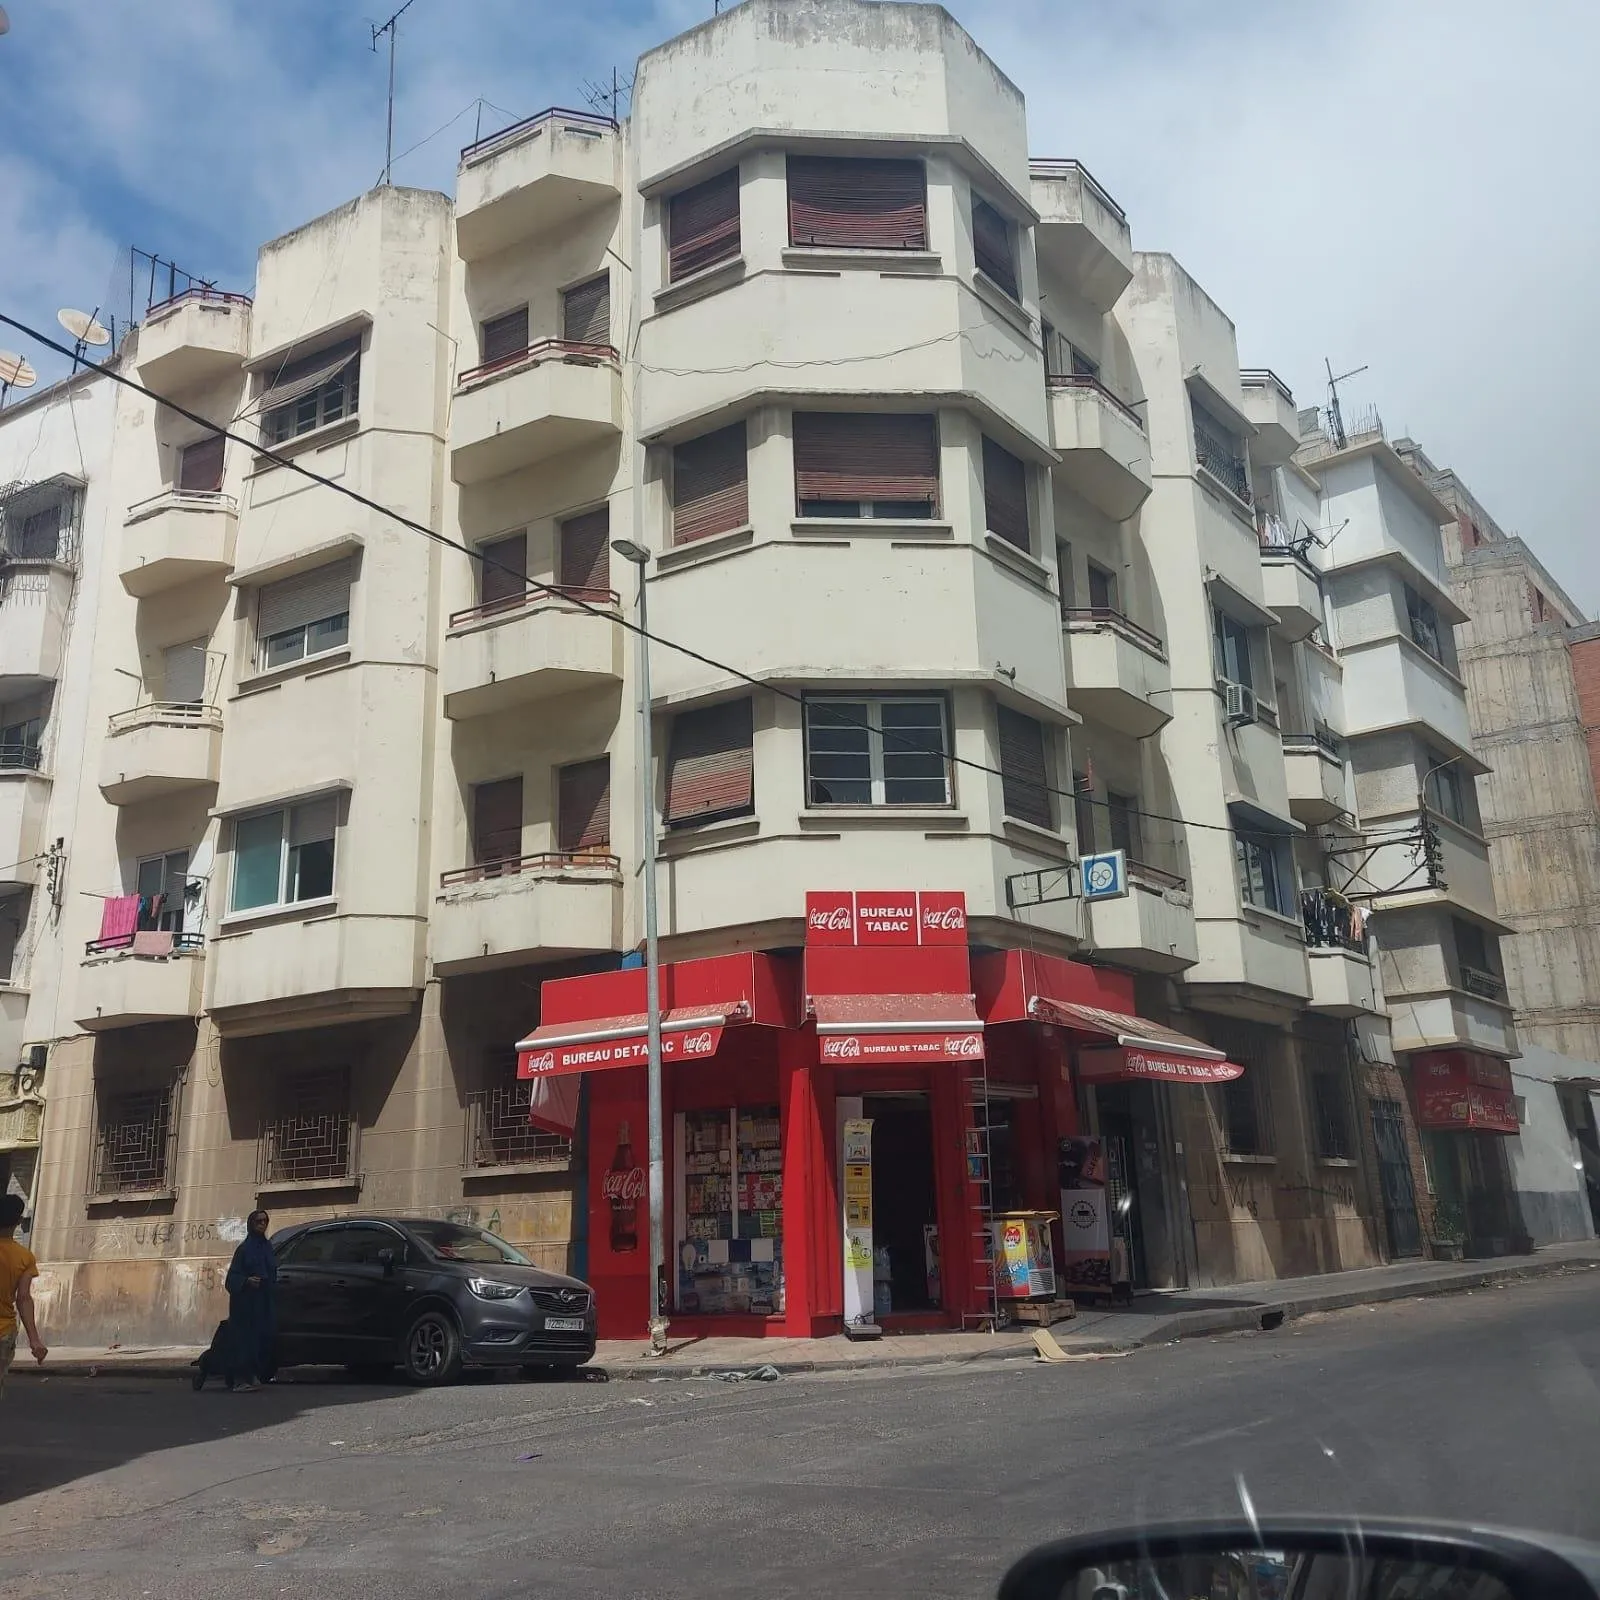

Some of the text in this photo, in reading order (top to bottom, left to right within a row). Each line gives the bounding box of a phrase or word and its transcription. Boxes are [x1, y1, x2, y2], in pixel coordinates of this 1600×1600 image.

[808, 907, 852, 931] Coca-Cola
[860, 907, 913, 918] BUREAU
[922, 906, 965, 930] Coca-Cola
[865, 921, 909, 932] TABAC
[527, 1032, 712, 1073] Coca-Cola BUREAU DE TAAC Coca-Cola
[823, 1035, 982, 1058] Coca-Cola BUREAU DE TABAC Coca-Cola
[1146, 1060, 1177, 1075] BUREAU
[1177, 1064, 1188, 1076] DE
[1187, 1065, 1212, 1077] TABAC
[601, 1167, 647, 1200] Coca-Cola
